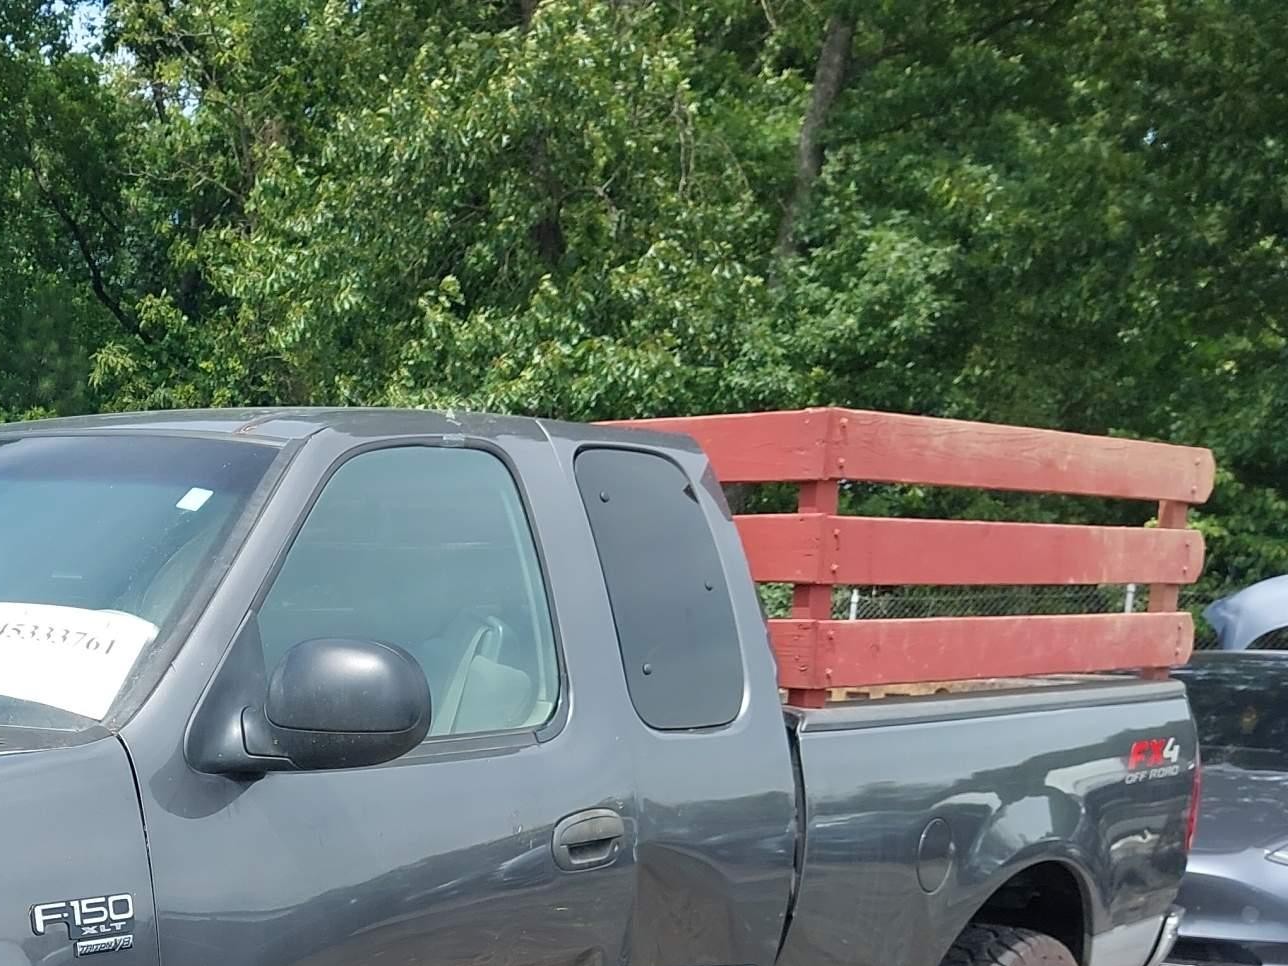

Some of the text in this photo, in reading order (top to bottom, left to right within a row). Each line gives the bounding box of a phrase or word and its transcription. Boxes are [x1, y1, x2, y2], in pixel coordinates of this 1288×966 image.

[1128, 737, 1180, 771] FX4
[1125, 765, 1180, 784] OFF ROAD
[81, 921, 127, 936] XLT
